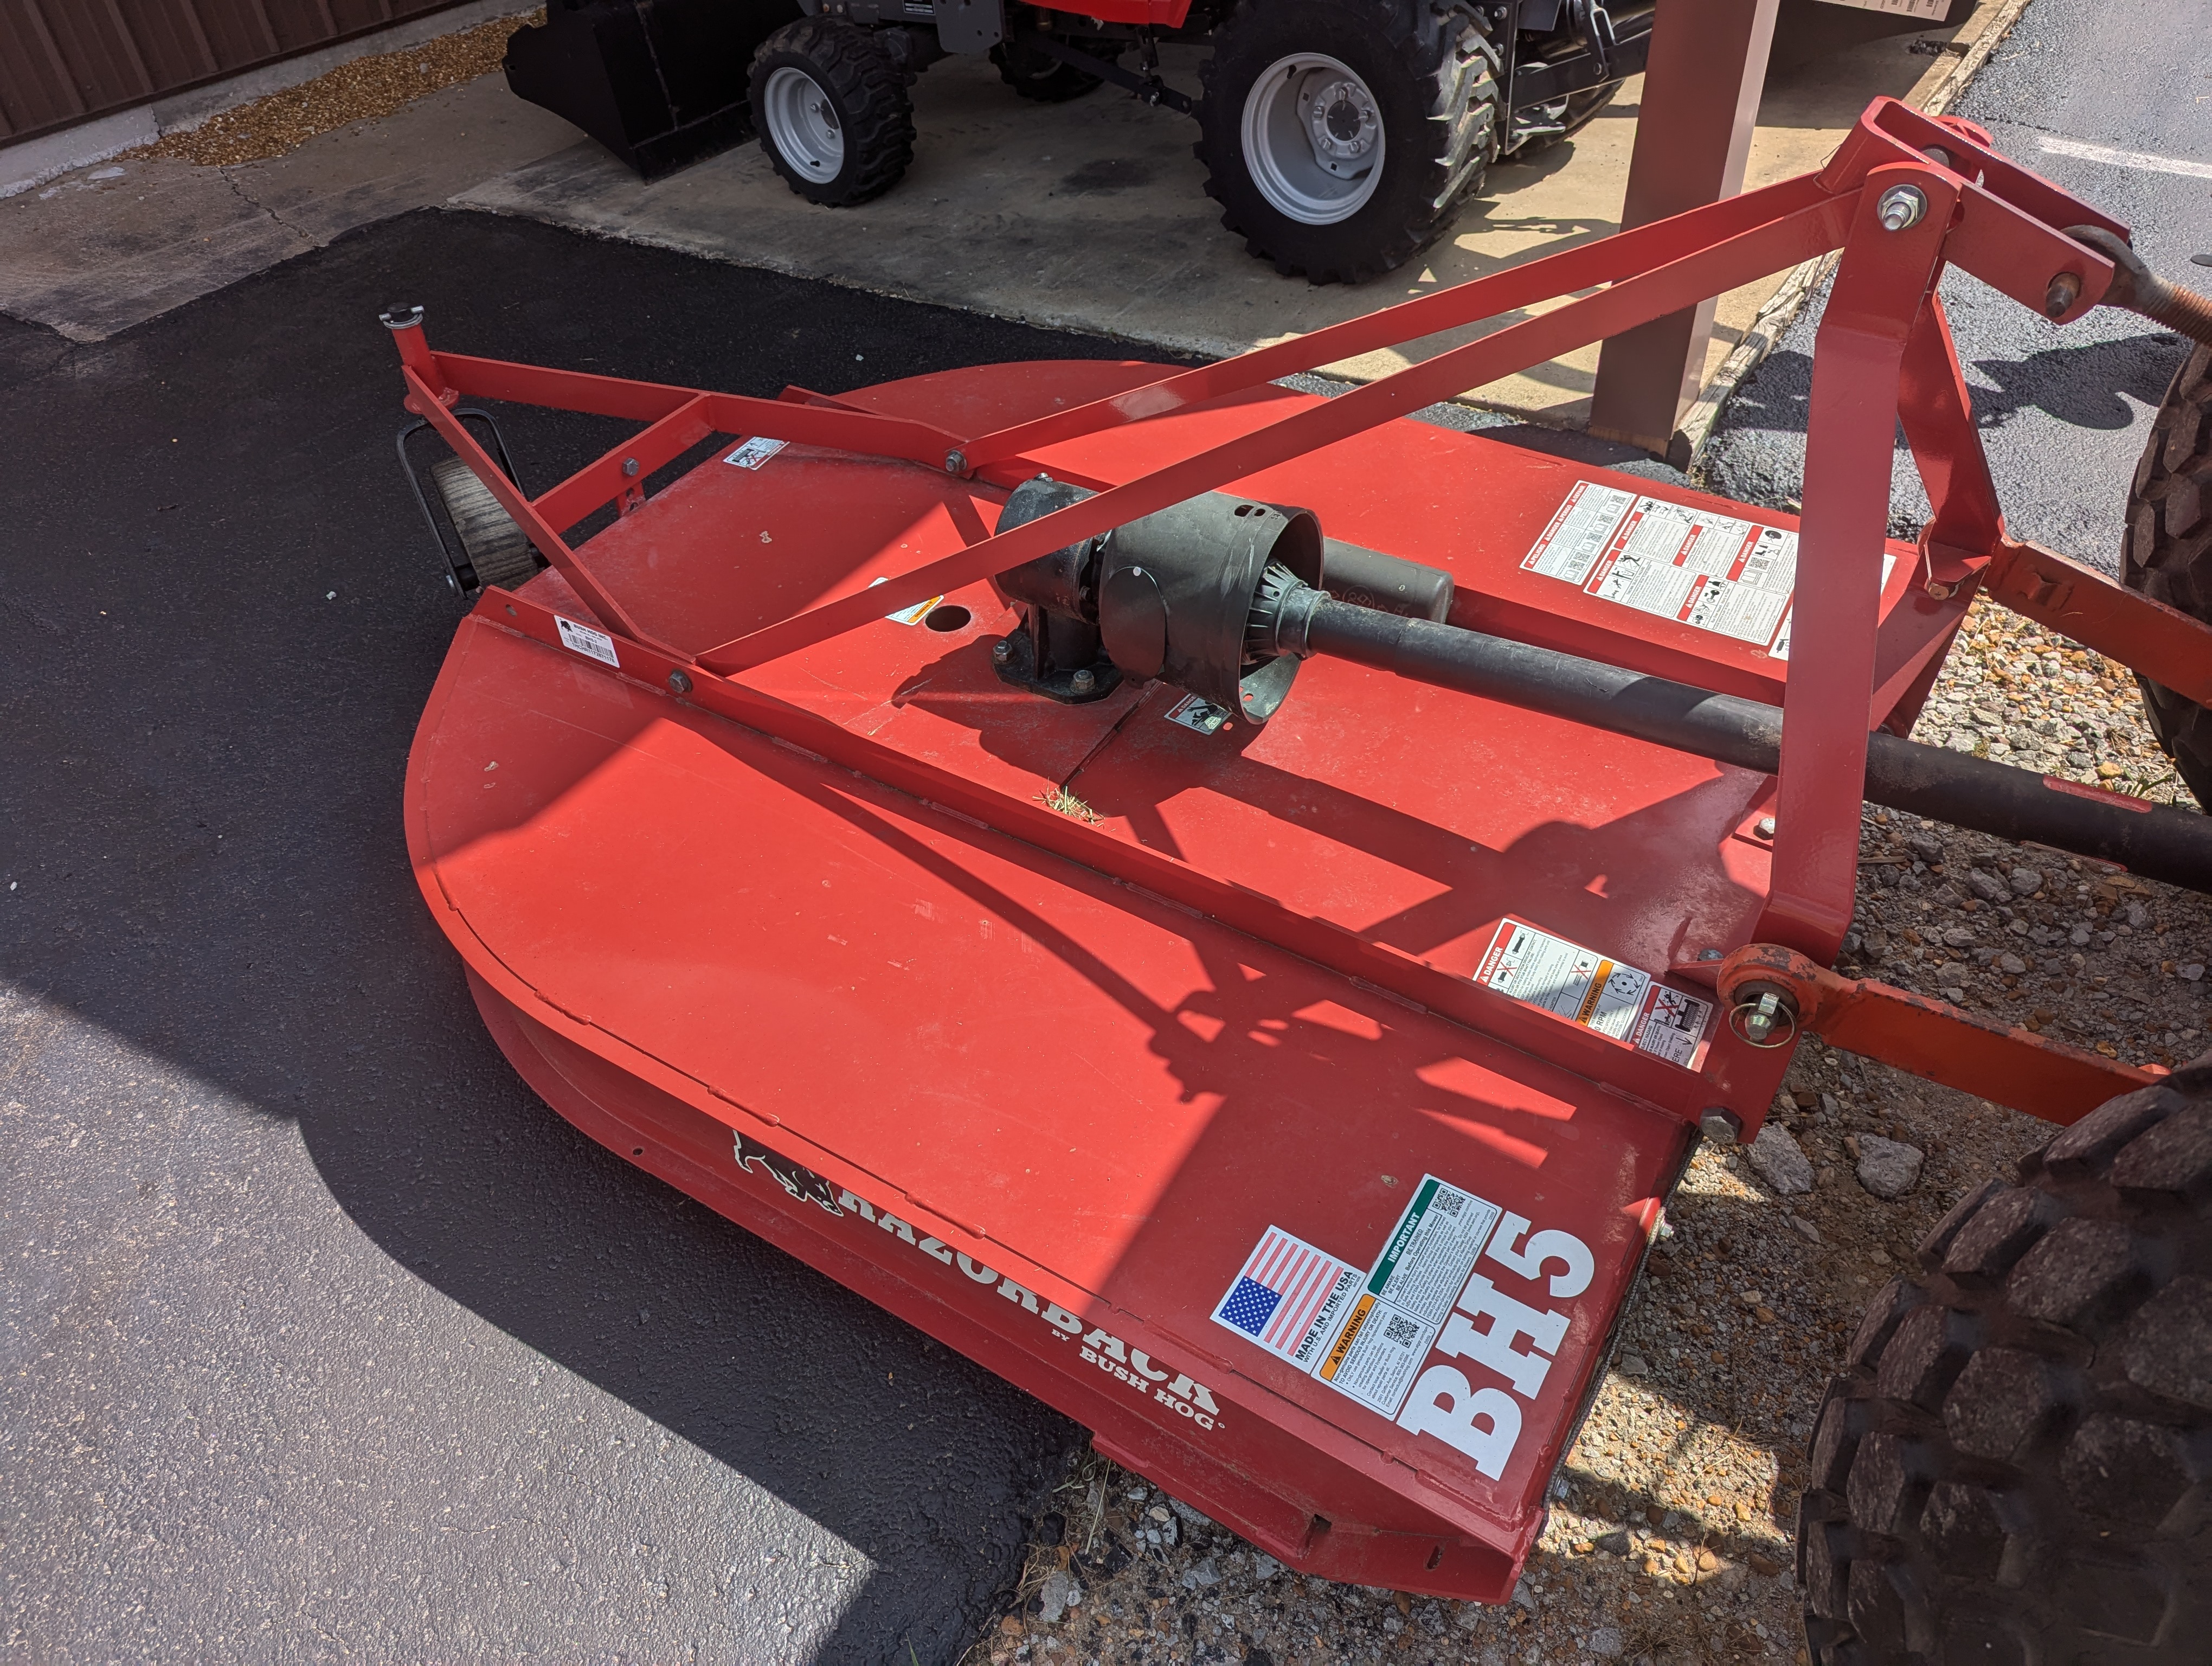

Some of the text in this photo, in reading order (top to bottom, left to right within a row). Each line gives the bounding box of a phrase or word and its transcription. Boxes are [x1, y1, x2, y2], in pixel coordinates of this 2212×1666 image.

[1546, 521, 1561, 537] DANGER
[1623, 520, 1637, 536] DANGER
[1531, 543, 1546, 561] PELIGRO
[1682, 534, 1696, 550] DANGER
[1740, 541, 1753, 558] DANGER
[1598, 560, 1613, 576] DANGER
[1688, 586, 1702, 604] DANGER
[1181, 696, 1197, 709] DANGE
[1483, 946, 1503, 975] DANGER
[1581, 982, 1602, 1016] WARNING
[1635, 1012, 1650, 1036] DANGER
[1387, 1212, 1419, 1262] IMPORTANT
[1404, 1256, 1416, 1271] Before
[1412, 1236, 1427, 1256] Operating
[1428, 1214, 1438, 1228] Mower
[1405, 1228, 1423, 1255] BE TRAINED
[1385, 1274, 1395, 1290] AWARE
[1391, 1274, 1400, 1288] ALERT
[1399, 1272, 1408, 1285] ALIVE
[1295, 1271, 1353, 1361] MADE IN THE USA
[1303, 1347, 1315, 1362] WITH
[1312, 1336, 1322, 1347] U.S.
[1320, 1322, 1329, 1335] AND
[1327, 1292, 1346, 1321] IMPORTED
[1344, 1273, 1358, 1292] PARTS
[1333, 1356, 1350, 1382] Non-genuine
[1348, 1345, 1356, 1357] parts
[1362, 1301, 1381, 1331] catastrophically.
[1336, 1309, 1366, 1353] WARNING
[1356, 1353, 1365, 1366] genuine
[1371, 1319, 1383, 1338] replacement
[1342, 1364, 1352, 1378] AVOID
[1349, 1345, 1362, 1364] SERIOUS
[1359, 1330, 1371, 1346] INJURY
[1371, 1309, 1382, 1324] DEATH:
[1397, 1210, 1594, 1481] BH5
[1051, 1329, 1214, 1431] BY BUSH HOG
[1353, 1364, 1366, 1385] Non-genuine
[1366, 1383, 1375, 1396] Contact
